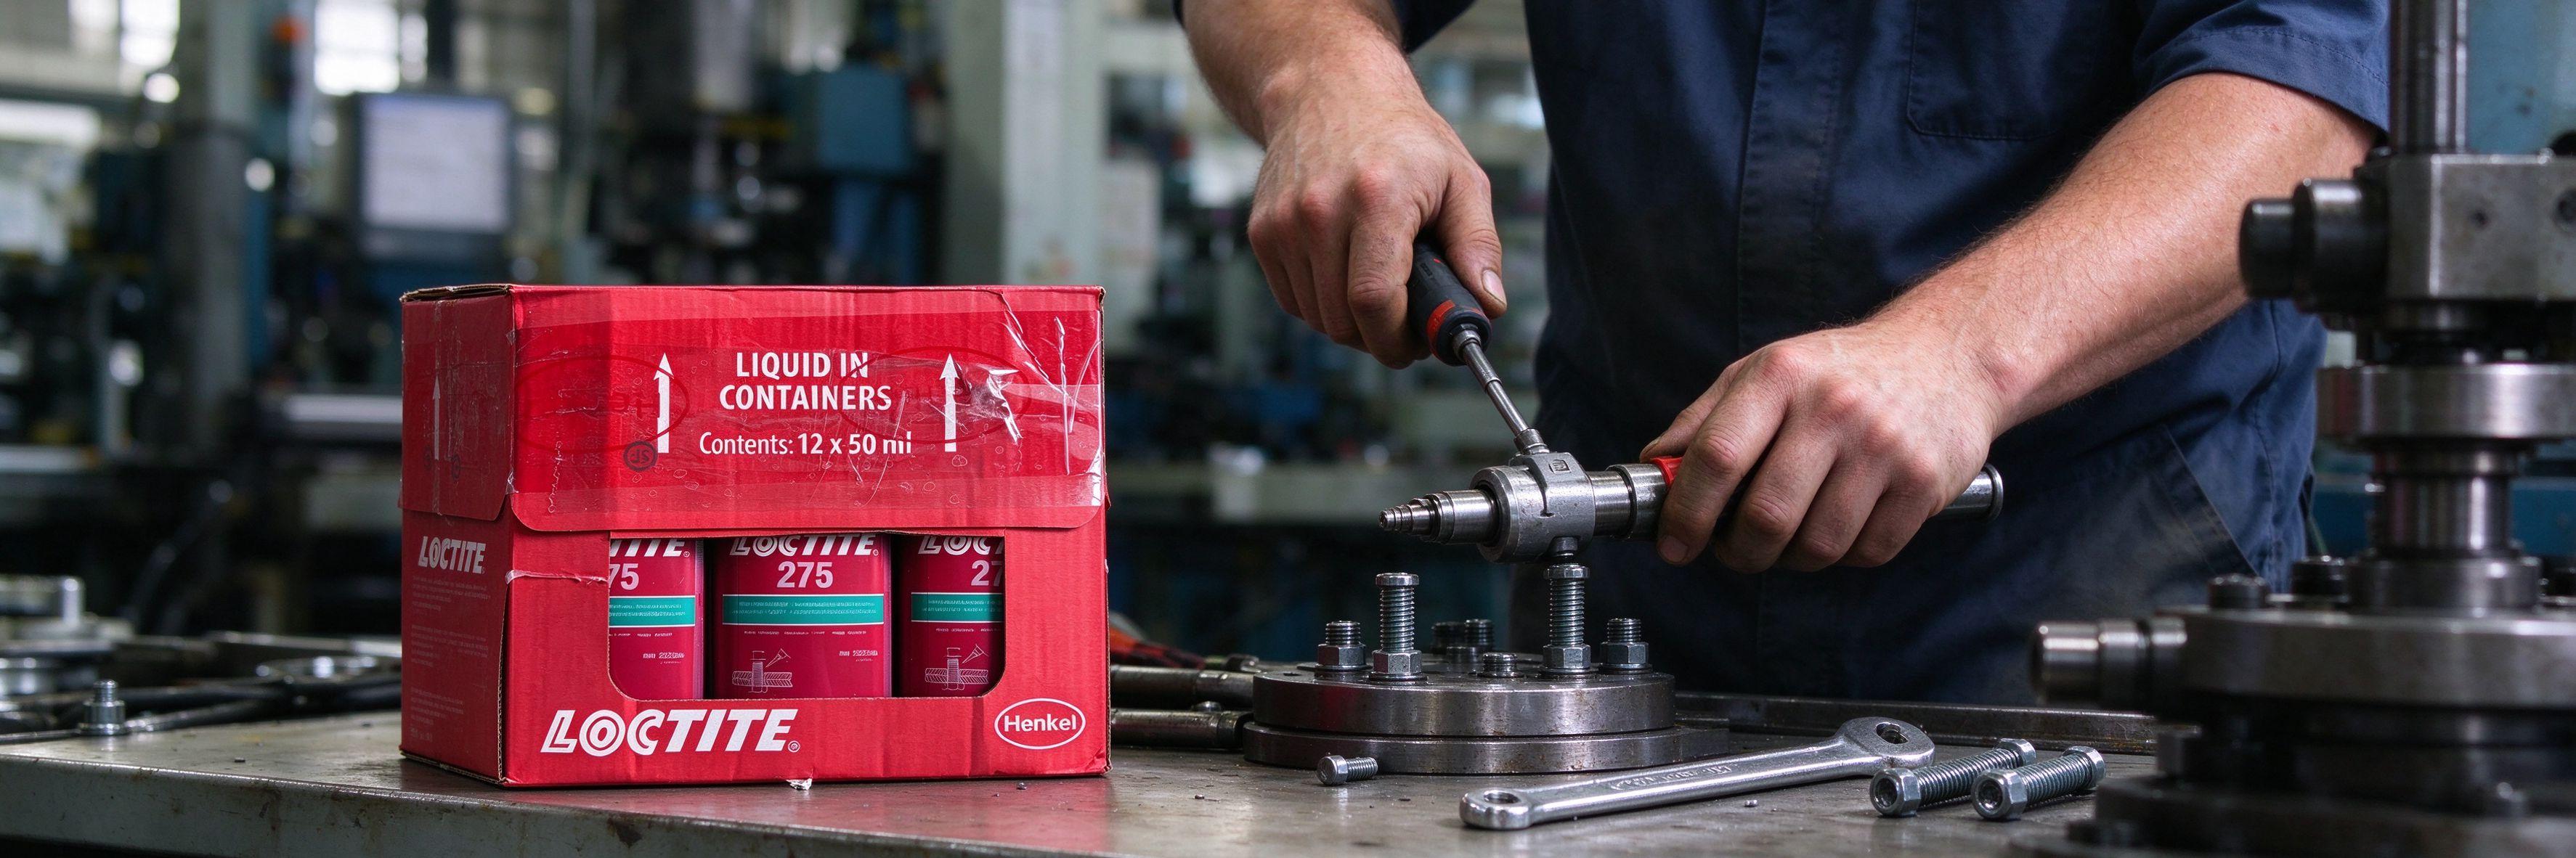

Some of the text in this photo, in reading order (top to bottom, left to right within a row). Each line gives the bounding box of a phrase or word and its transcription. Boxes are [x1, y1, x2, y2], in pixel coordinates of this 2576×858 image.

[736, 351, 869, 380] LIQUID IN
[719, 384, 893, 411] CONTAINERS
[699, 431, 794, 455] Contents:
[797, 433, 823, 454] 12
[829, 438, 842, 454] x
[848, 433, 877, 455] 50
[418, 536, 486, 574] LOCTITE
[609, 563, 639, 590] 75
[776, 560, 834, 589] 275
[970, 560, 1003, 587] 27
[540, 708, 799, 757] LOCTITE
[1004, 714, 1077, 732] Henkel
